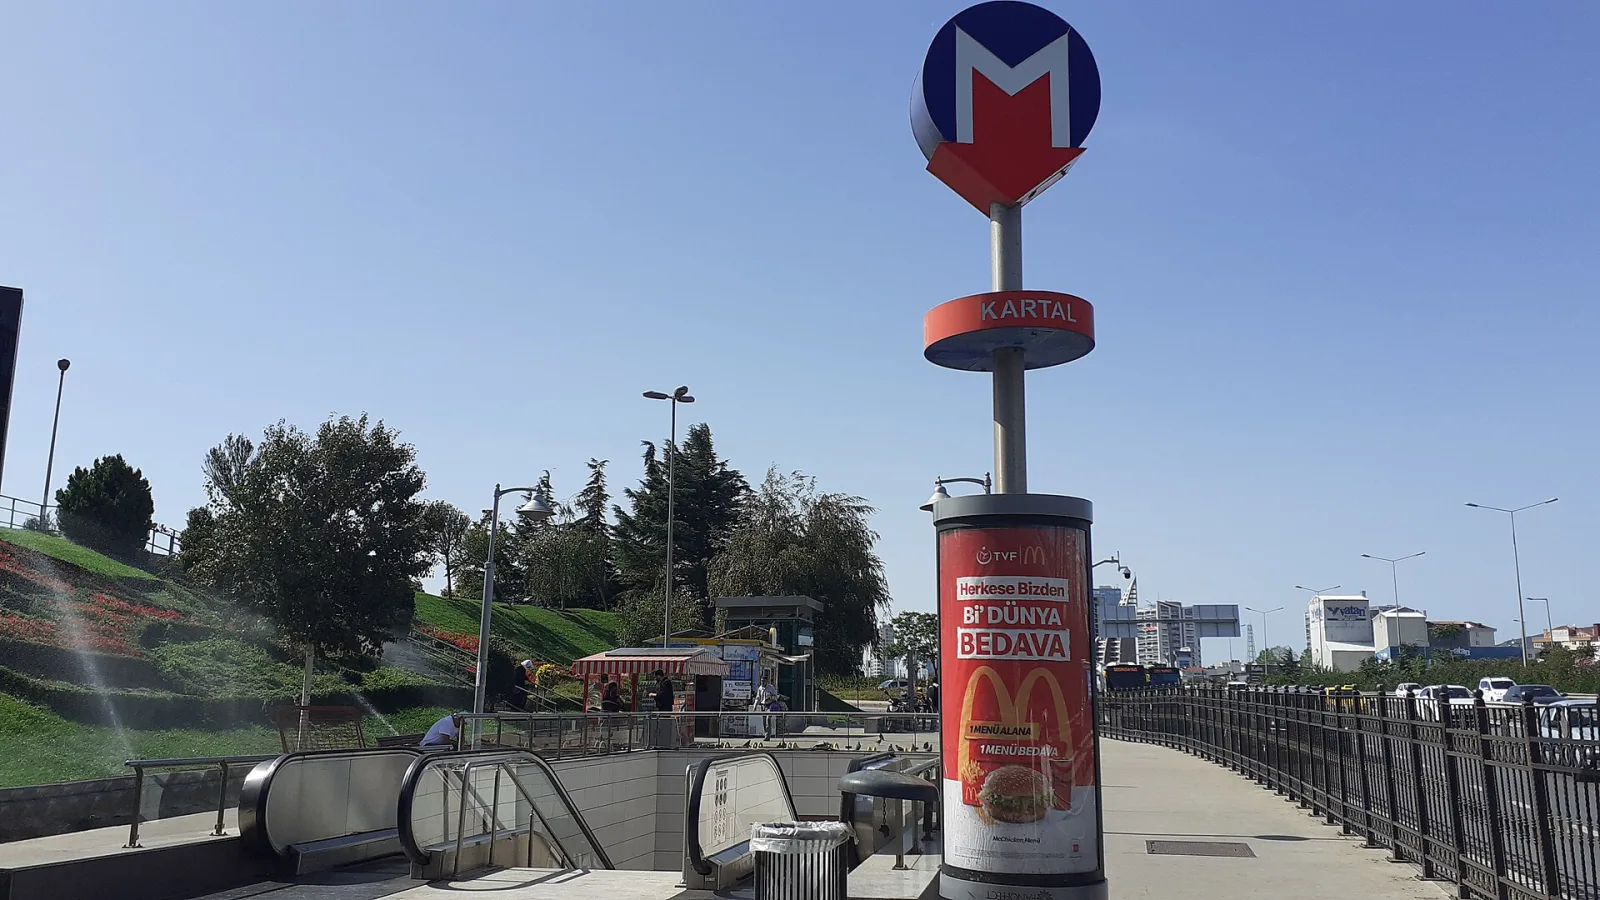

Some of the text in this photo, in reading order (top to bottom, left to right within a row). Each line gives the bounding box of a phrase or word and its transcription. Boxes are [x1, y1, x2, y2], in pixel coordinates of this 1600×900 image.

[953, 21, 1071, 148] M
[981, 299, 1077, 323] KARTAL
[994, 551, 1017, 561] TVF
[960, 581, 1065, 597] Herkese Bizden
[987, 601, 1062, 625] DÜNYA
[961, 633, 1066, 657] BEDAVA
[1000, 727, 1031, 736] ALANA
[985, 743, 1017, 755] MENÜ
[1018, 746, 1058, 757] BEDAVA
